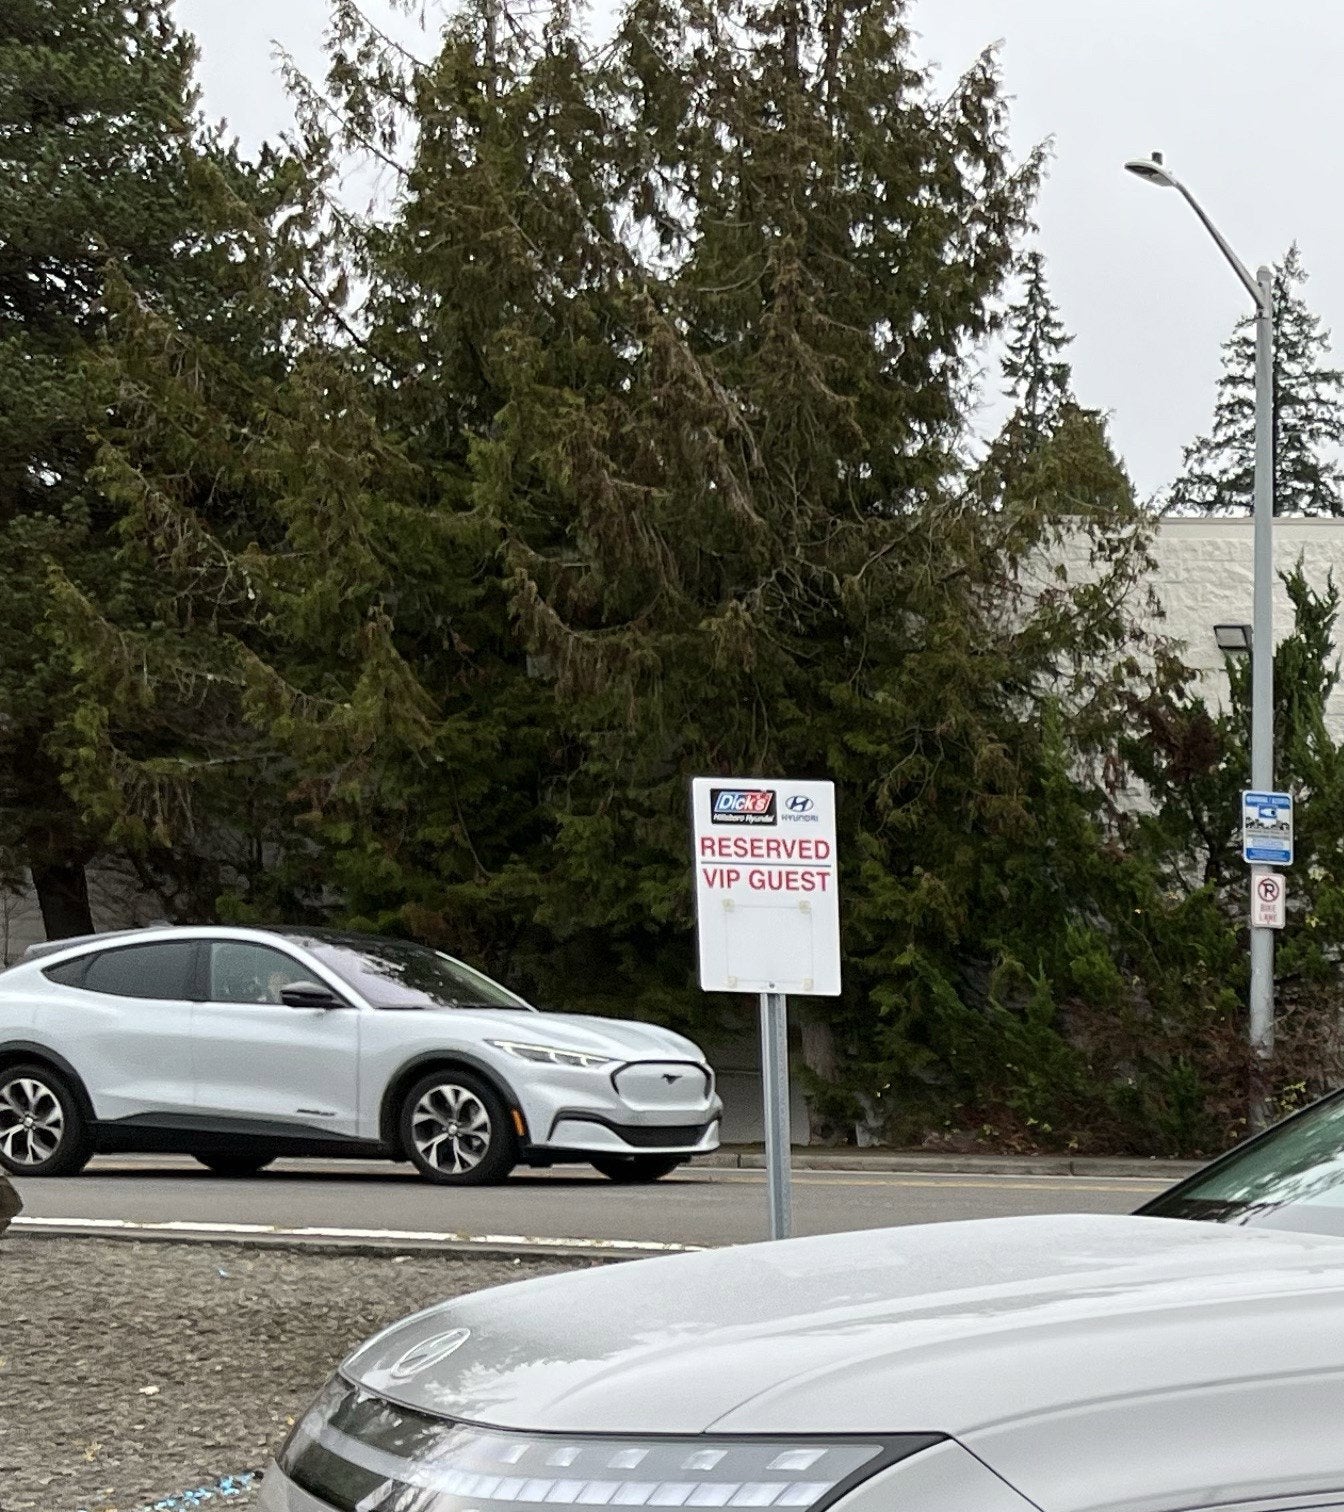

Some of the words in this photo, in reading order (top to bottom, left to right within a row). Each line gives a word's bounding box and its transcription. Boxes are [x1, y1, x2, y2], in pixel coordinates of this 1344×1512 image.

[700, 836, 830, 860] RESERVED
[702, 868, 741, 889] VIP
[748, 869, 831, 892] GUEST
